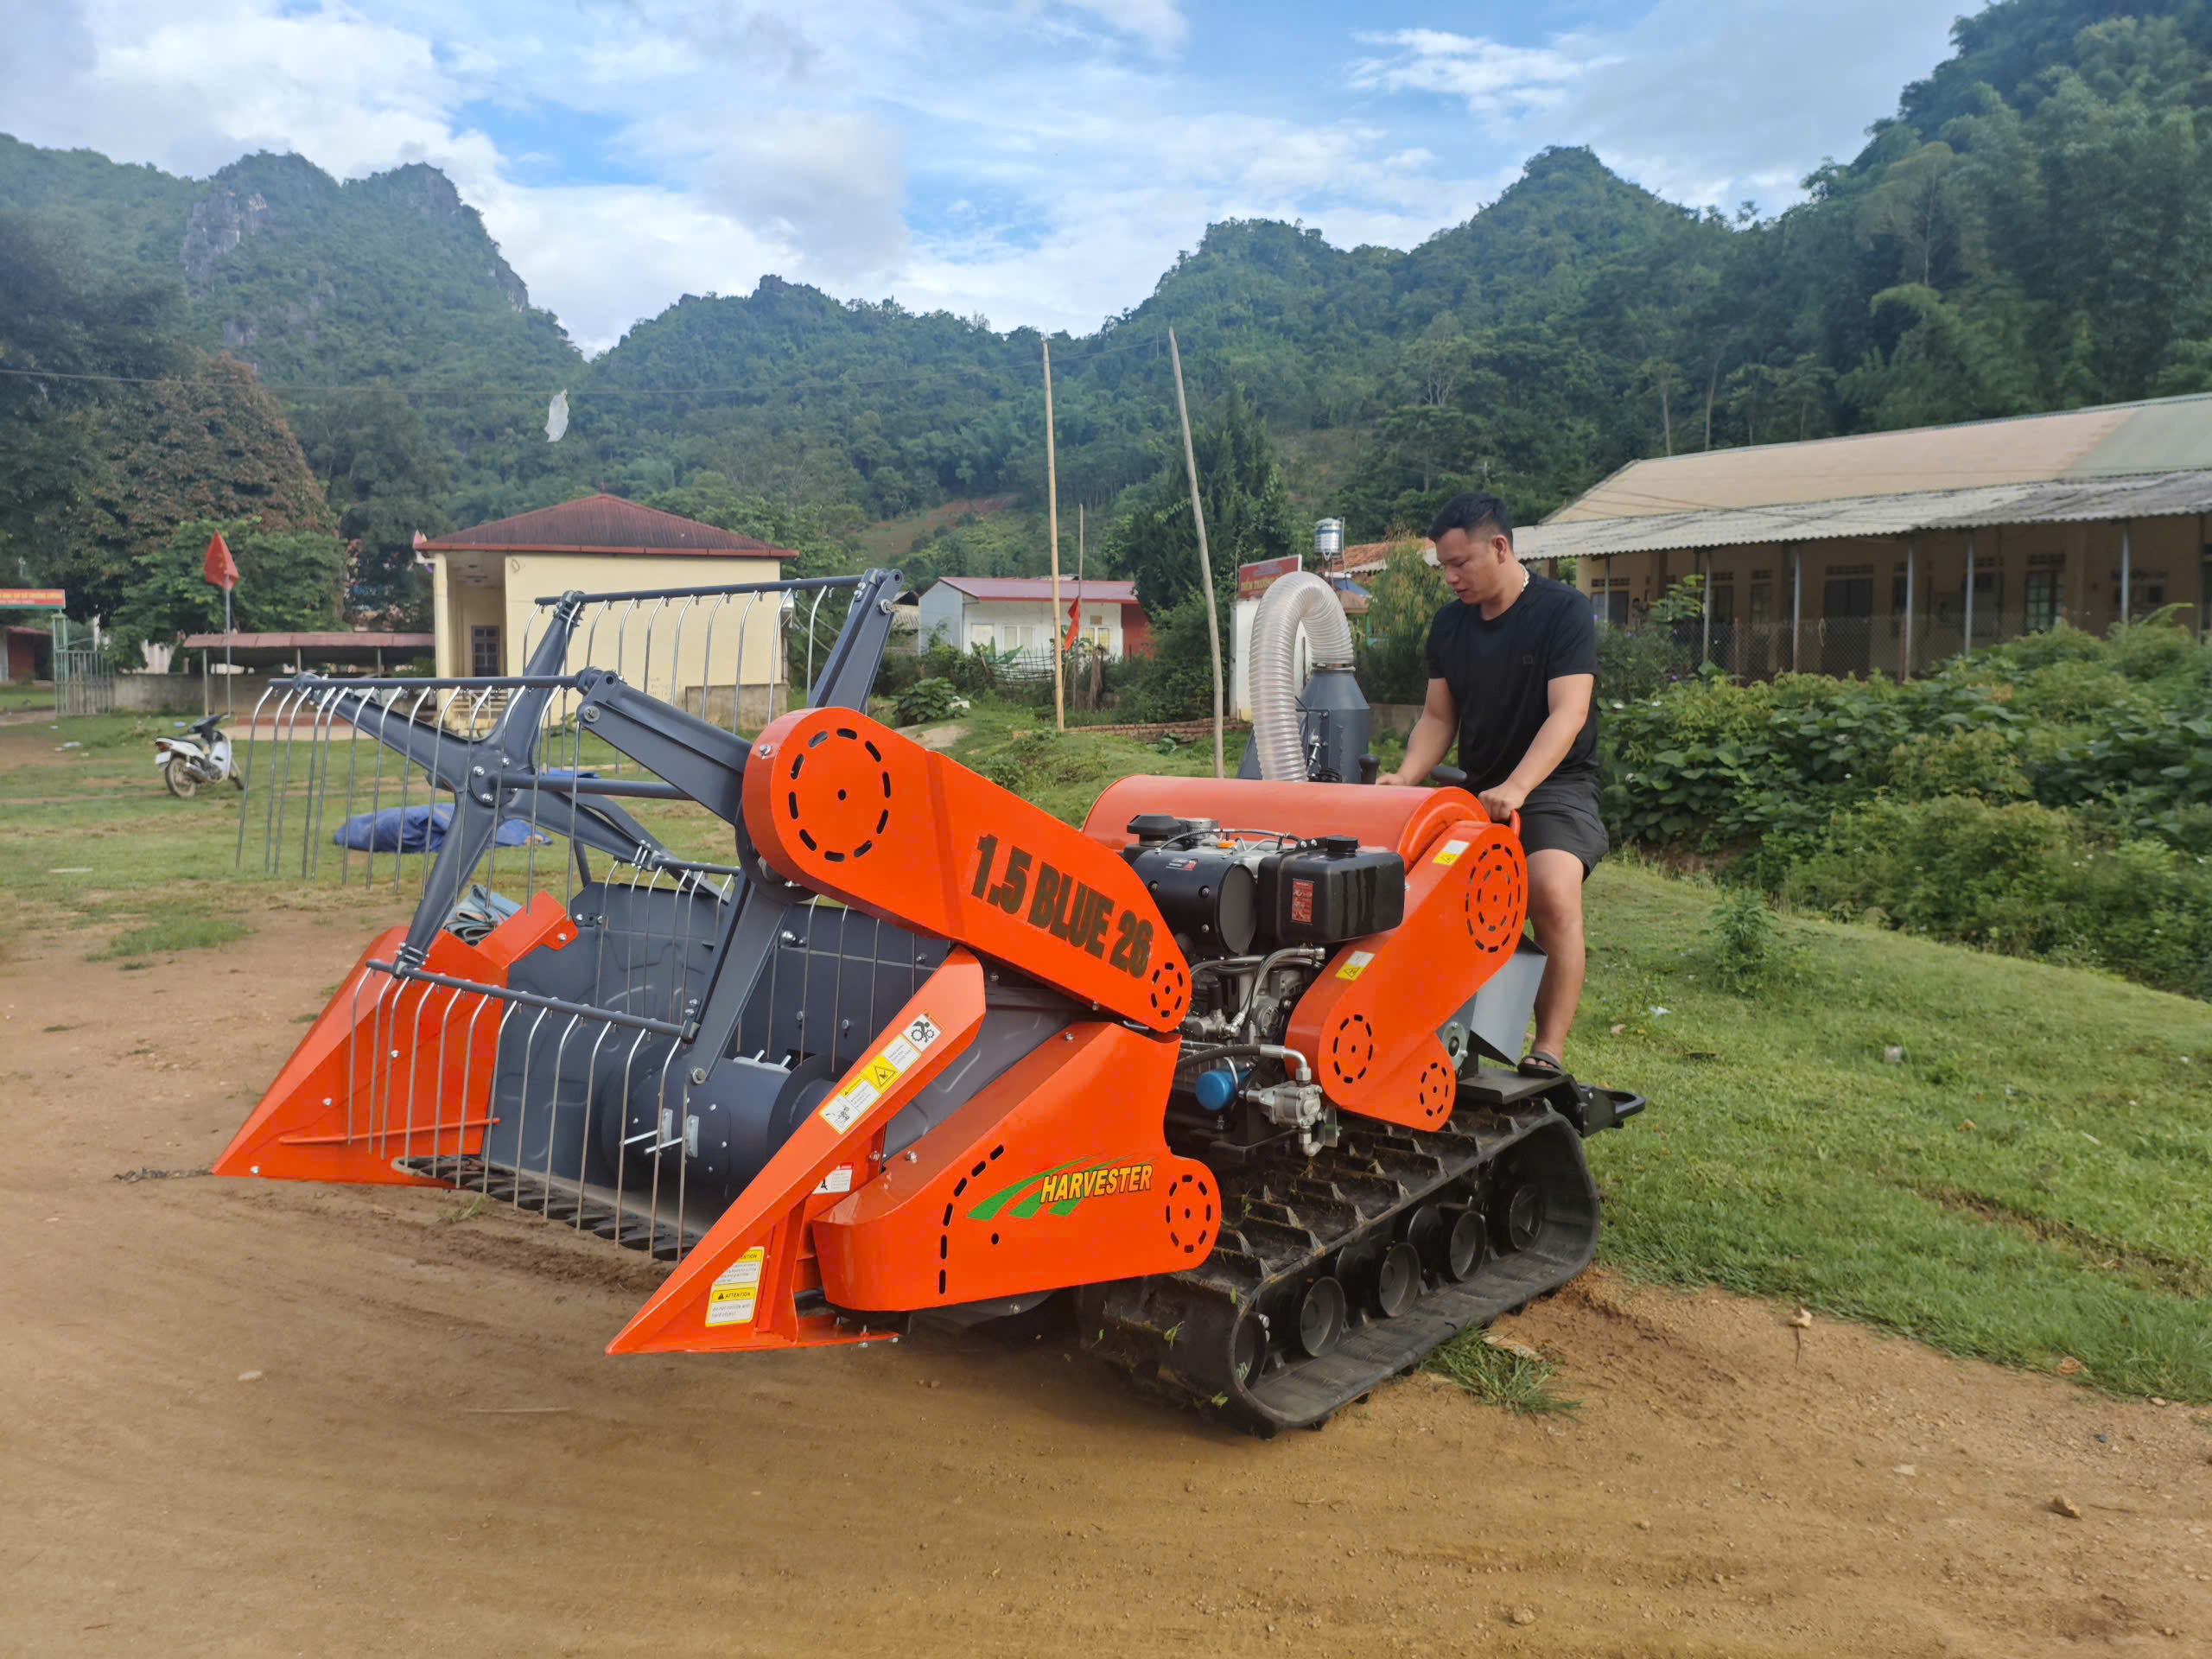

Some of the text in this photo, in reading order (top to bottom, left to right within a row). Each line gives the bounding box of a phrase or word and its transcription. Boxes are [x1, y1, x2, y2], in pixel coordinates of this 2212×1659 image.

[971, 834, 1154, 979] 1.5 BLUE 26
[1039, 1165, 1154, 1205] HARVESTER
